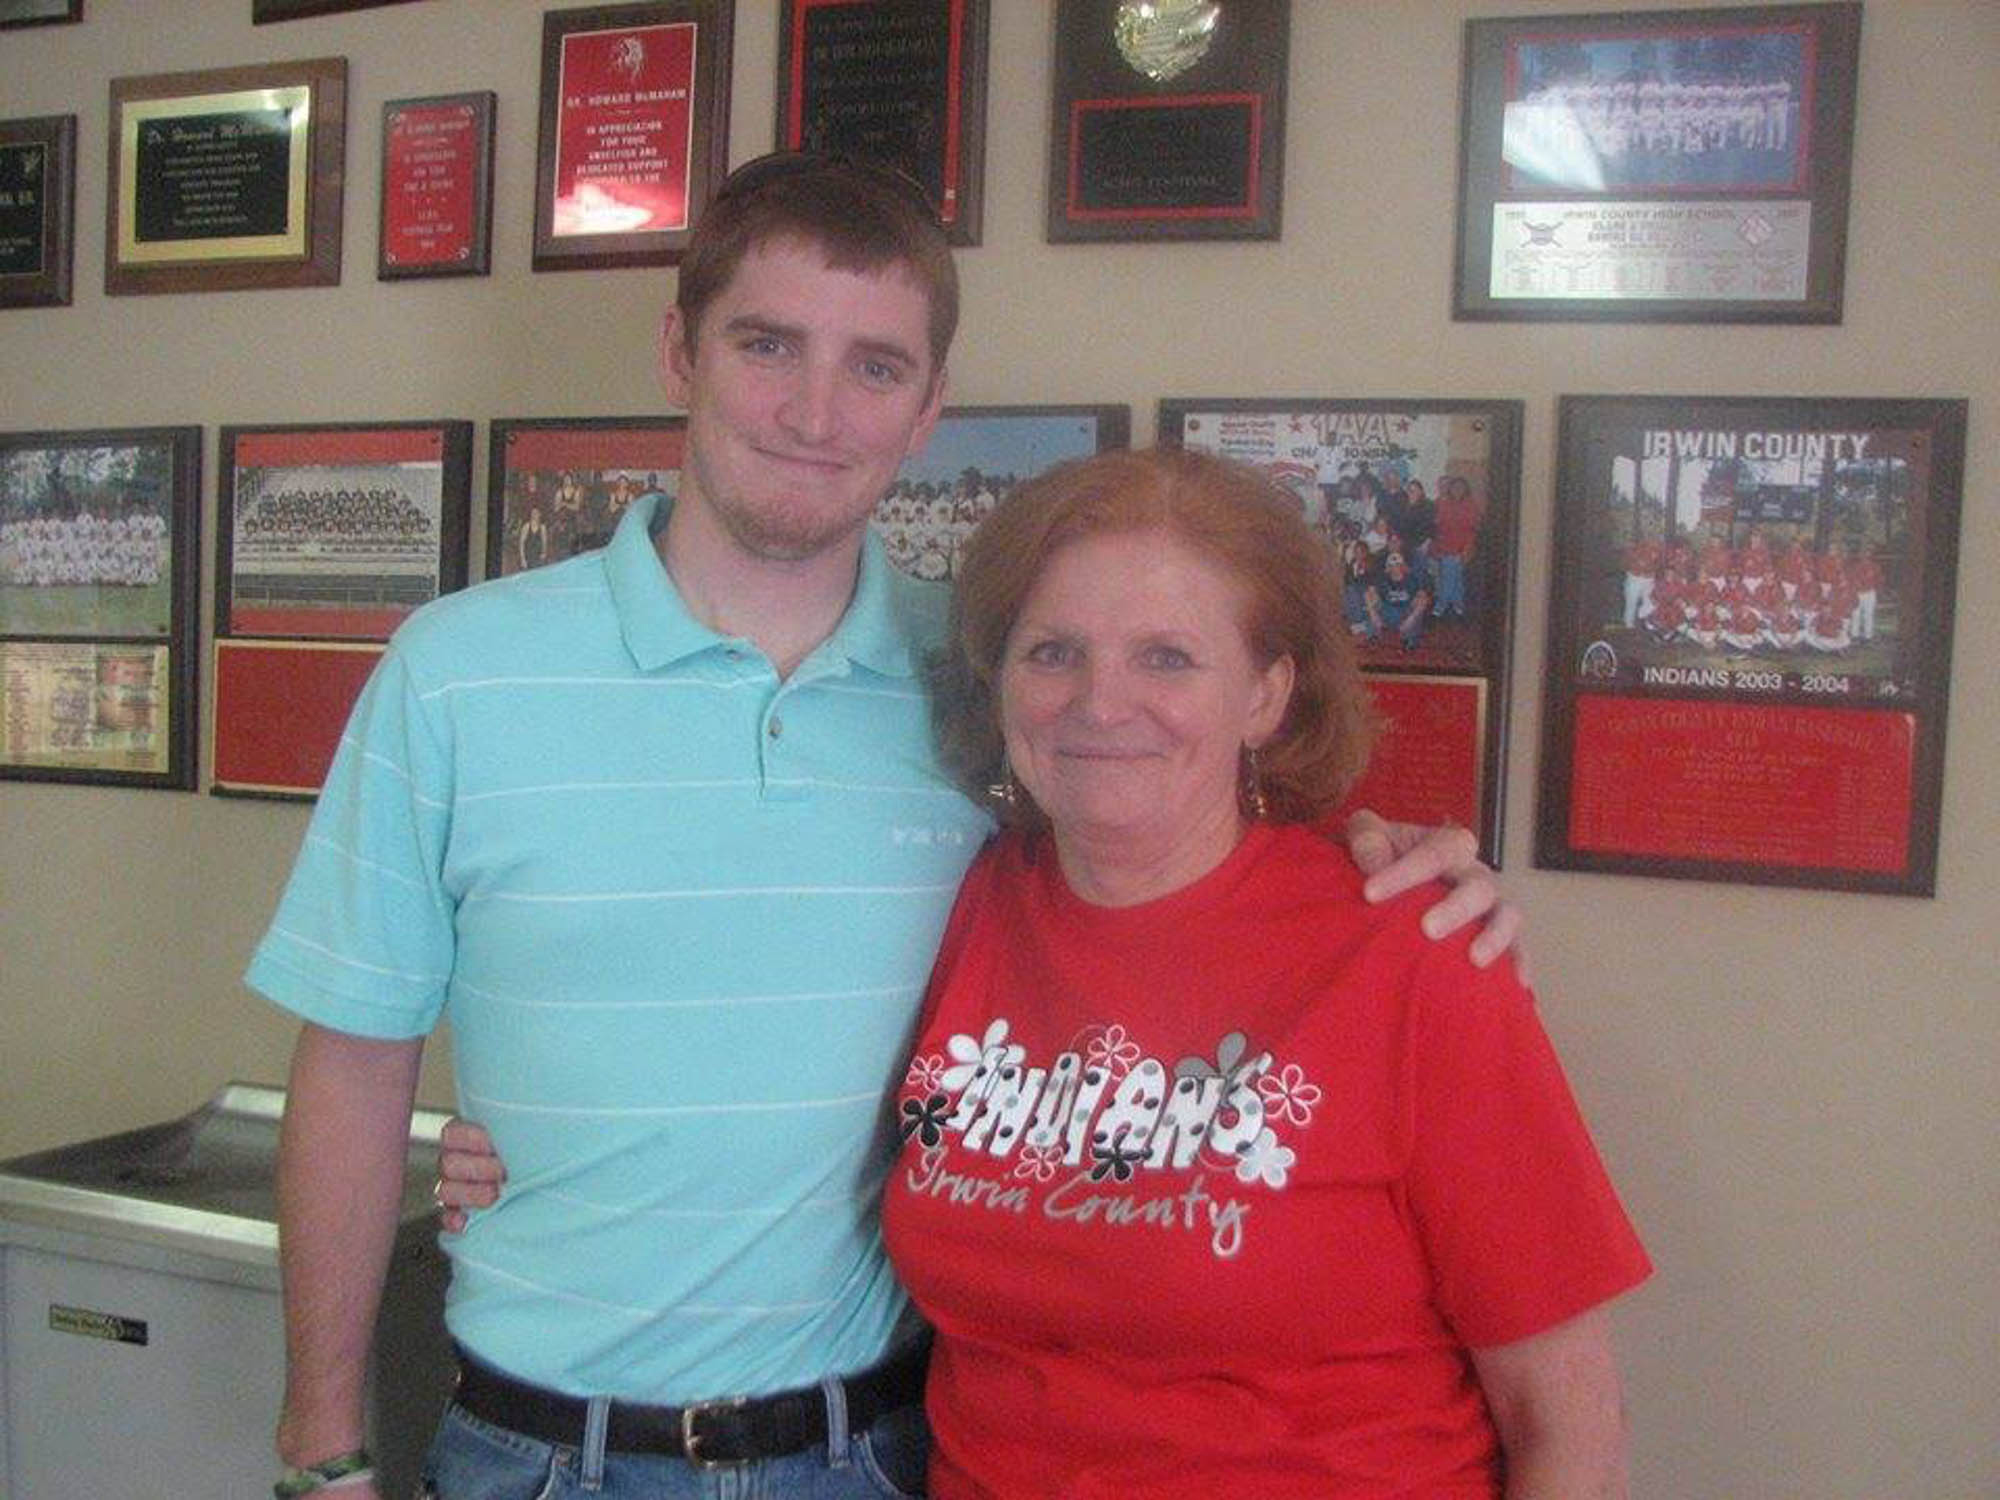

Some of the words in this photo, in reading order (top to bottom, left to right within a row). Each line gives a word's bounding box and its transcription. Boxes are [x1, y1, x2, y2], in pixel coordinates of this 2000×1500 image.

[599, 121, 662, 134] APPRECIATION
[639, 147, 658, 158] AND
[576, 162, 625, 175] DEDICATED
[627, 159, 668, 171] SUPPORT
[1643, 431, 1737, 458] IRWIN
[1744, 432, 1870, 460] COUNTY
[1643, 668, 1729, 687] INDIANS
[1735, 673, 1783, 689] 2003
[1802, 676, 1850, 693] 2004
[946, 1046, 1274, 1168] INDIANS
[908, 1147, 1031, 1212] Irwin
[1044, 1173, 1250, 1258] County
